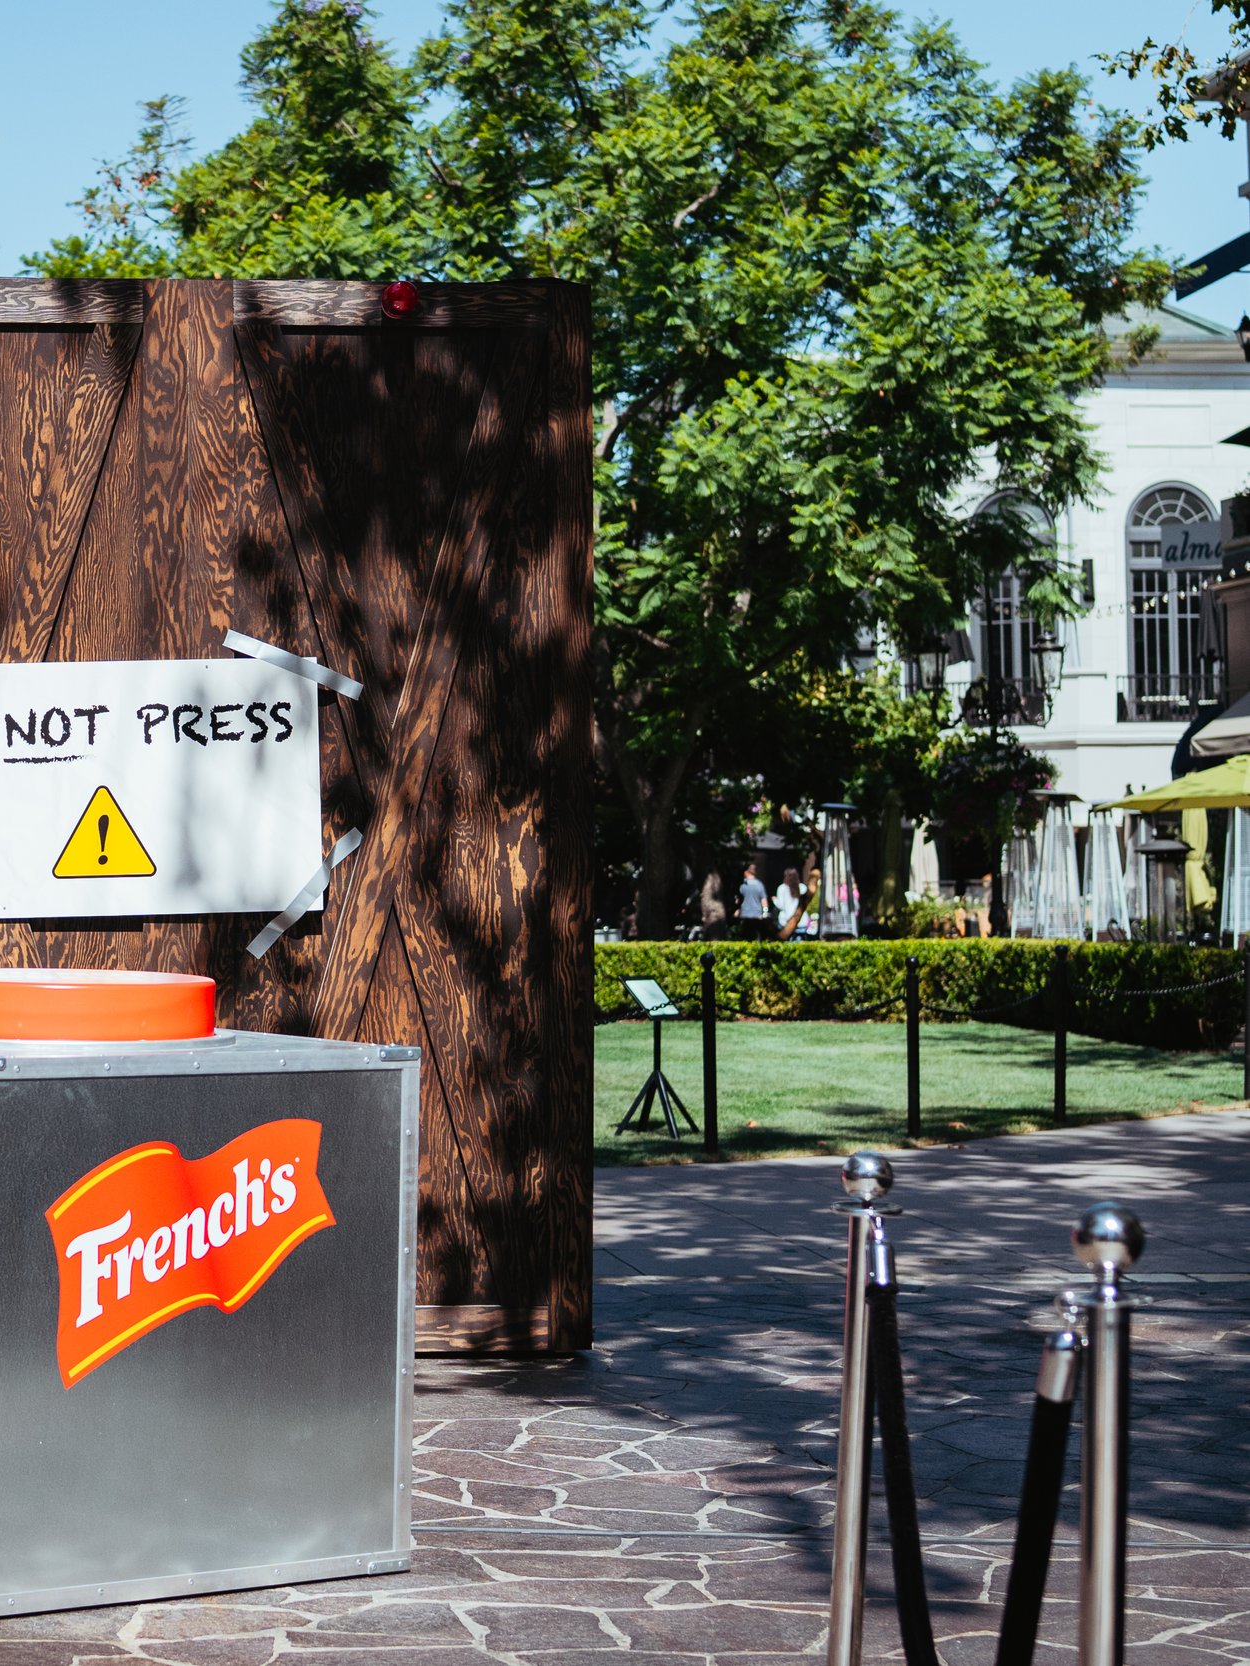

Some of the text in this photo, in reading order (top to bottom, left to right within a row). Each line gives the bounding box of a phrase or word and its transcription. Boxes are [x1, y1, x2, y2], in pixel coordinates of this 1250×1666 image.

[4, 704, 110, 748] NOT
[136, 701, 294, 747] PRESS
[65, 1157, 297, 1329] French's
